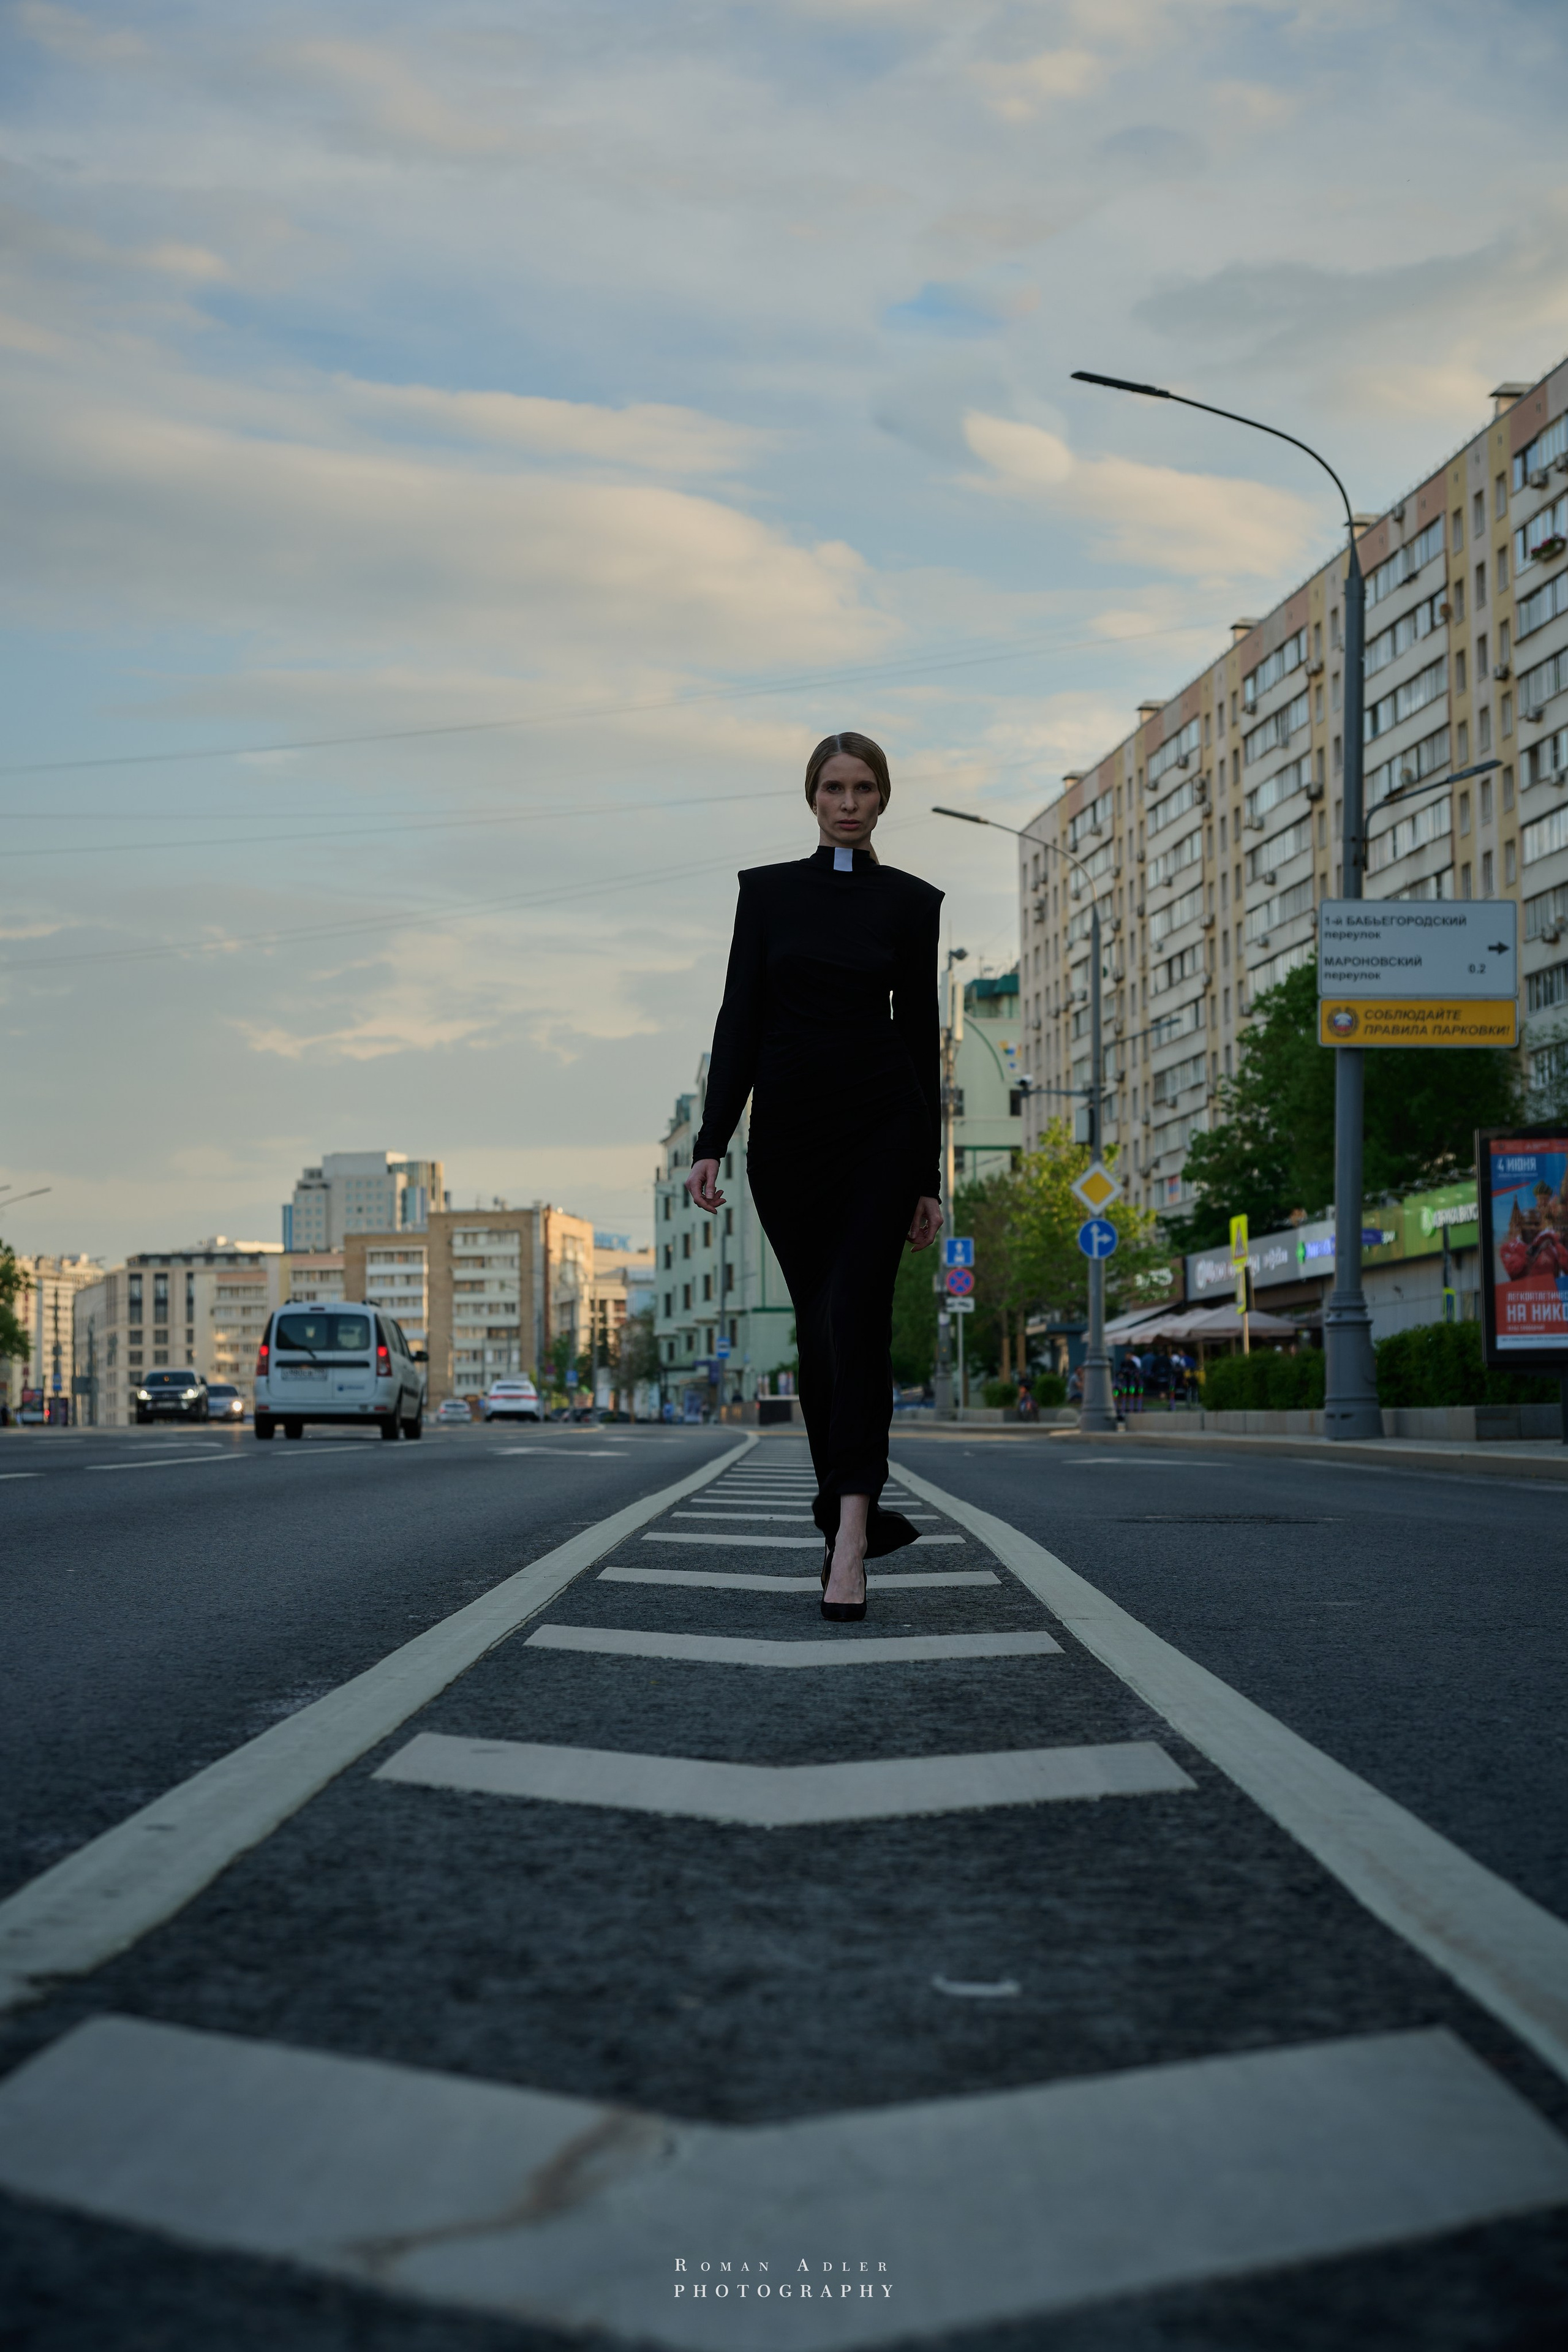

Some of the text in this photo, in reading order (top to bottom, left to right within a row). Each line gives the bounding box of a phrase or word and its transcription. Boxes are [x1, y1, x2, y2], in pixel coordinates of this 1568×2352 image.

[1325, 914, 1467, 927] 1-й БАБЬЕГОРОДСКИЙ
[1324, 931, 1381, 941] переулок
[1325, 955, 1422, 967] МАРОНОВСКИЙ
[1468, 963, 1486, 974] 0.2
[1324, 971, 1381, 982] переулок
[1365, 1008, 1462, 1021] СОБЛЮДАЙТЕ
[1364, 1025, 1510, 1036] ПРАВИЛА ПАРКОВКИ!
[1497, 1156, 1536, 1172] 4 ИЮНЯ
[1458, 1202, 1479, 1223] ВКУС
[1507, 1304, 1526, 1322] НА
